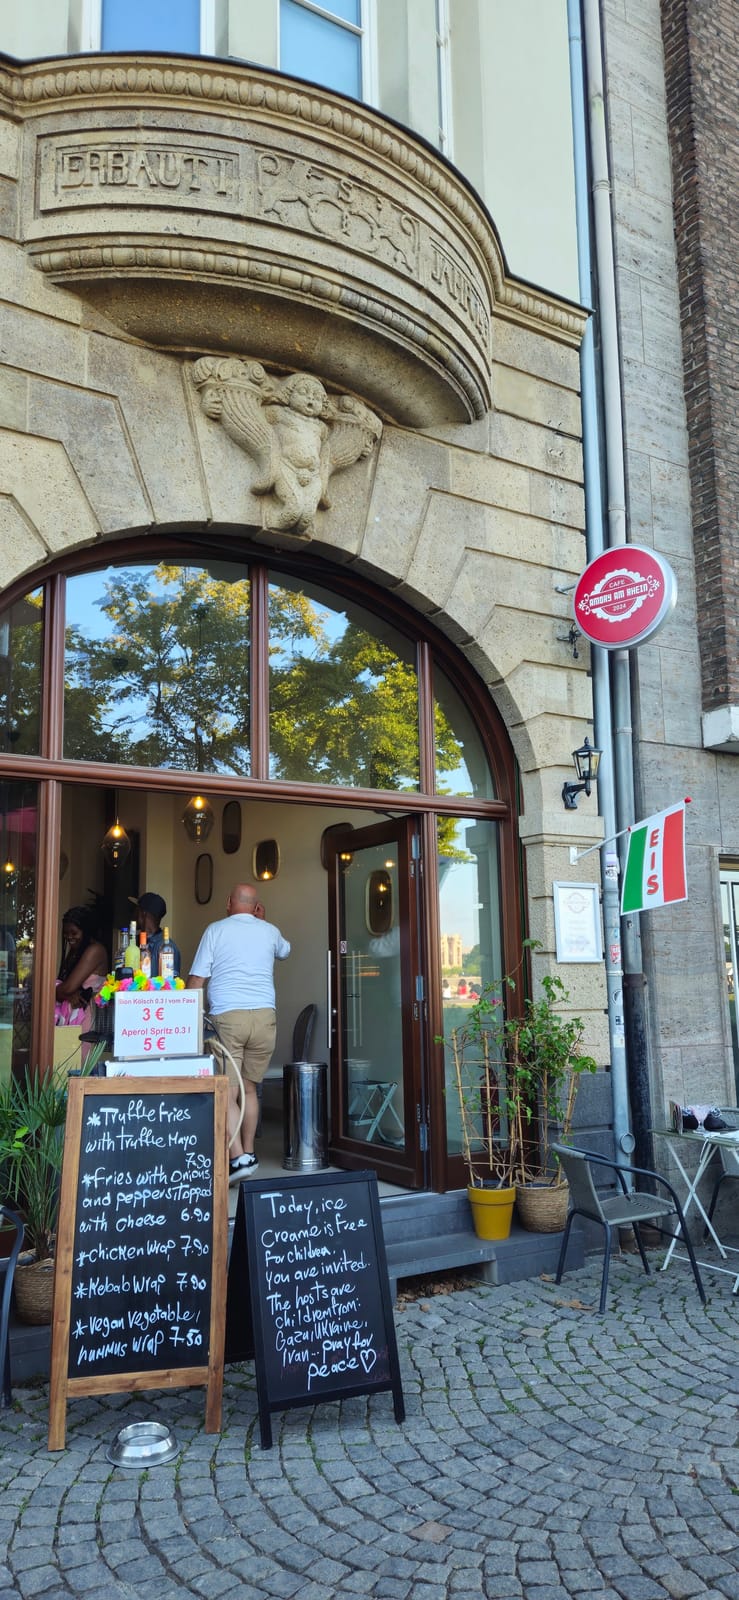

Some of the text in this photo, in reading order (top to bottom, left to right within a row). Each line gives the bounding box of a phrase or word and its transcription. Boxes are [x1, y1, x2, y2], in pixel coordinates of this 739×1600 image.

[613, 589, 625, 600] AM
[626, 583, 648, 597] RHEIN
[647, 828, 660, 895] EIS
[142, 1007, 164, 1021] 3 €
[121, 1028, 148, 1037] Aperol
[150, 1027, 173, 1036] Spritz
[143, 1036, 166, 1051] 5 €
[85, 1131, 115, 1153] with
[136, 1164, 168, 1186] with
[82, 1192, 111, 1208] and
[260, 1192, 348, 1225] Today, ice
[79, 1211, 108, 1233] with
[180, 1207, 210, 1222] 6.90
[323, 1221, 334, 1237] is
[335, 1212, 368, 1233] free
[180, 1235, 209, 1257] 7.90
[294, 1266, 319, 1281] are
[266, 1280, 356, 1316] The hosts are
[322, 1336, 351, 1364] pray
[307, 1357, 359, 1391] peace
